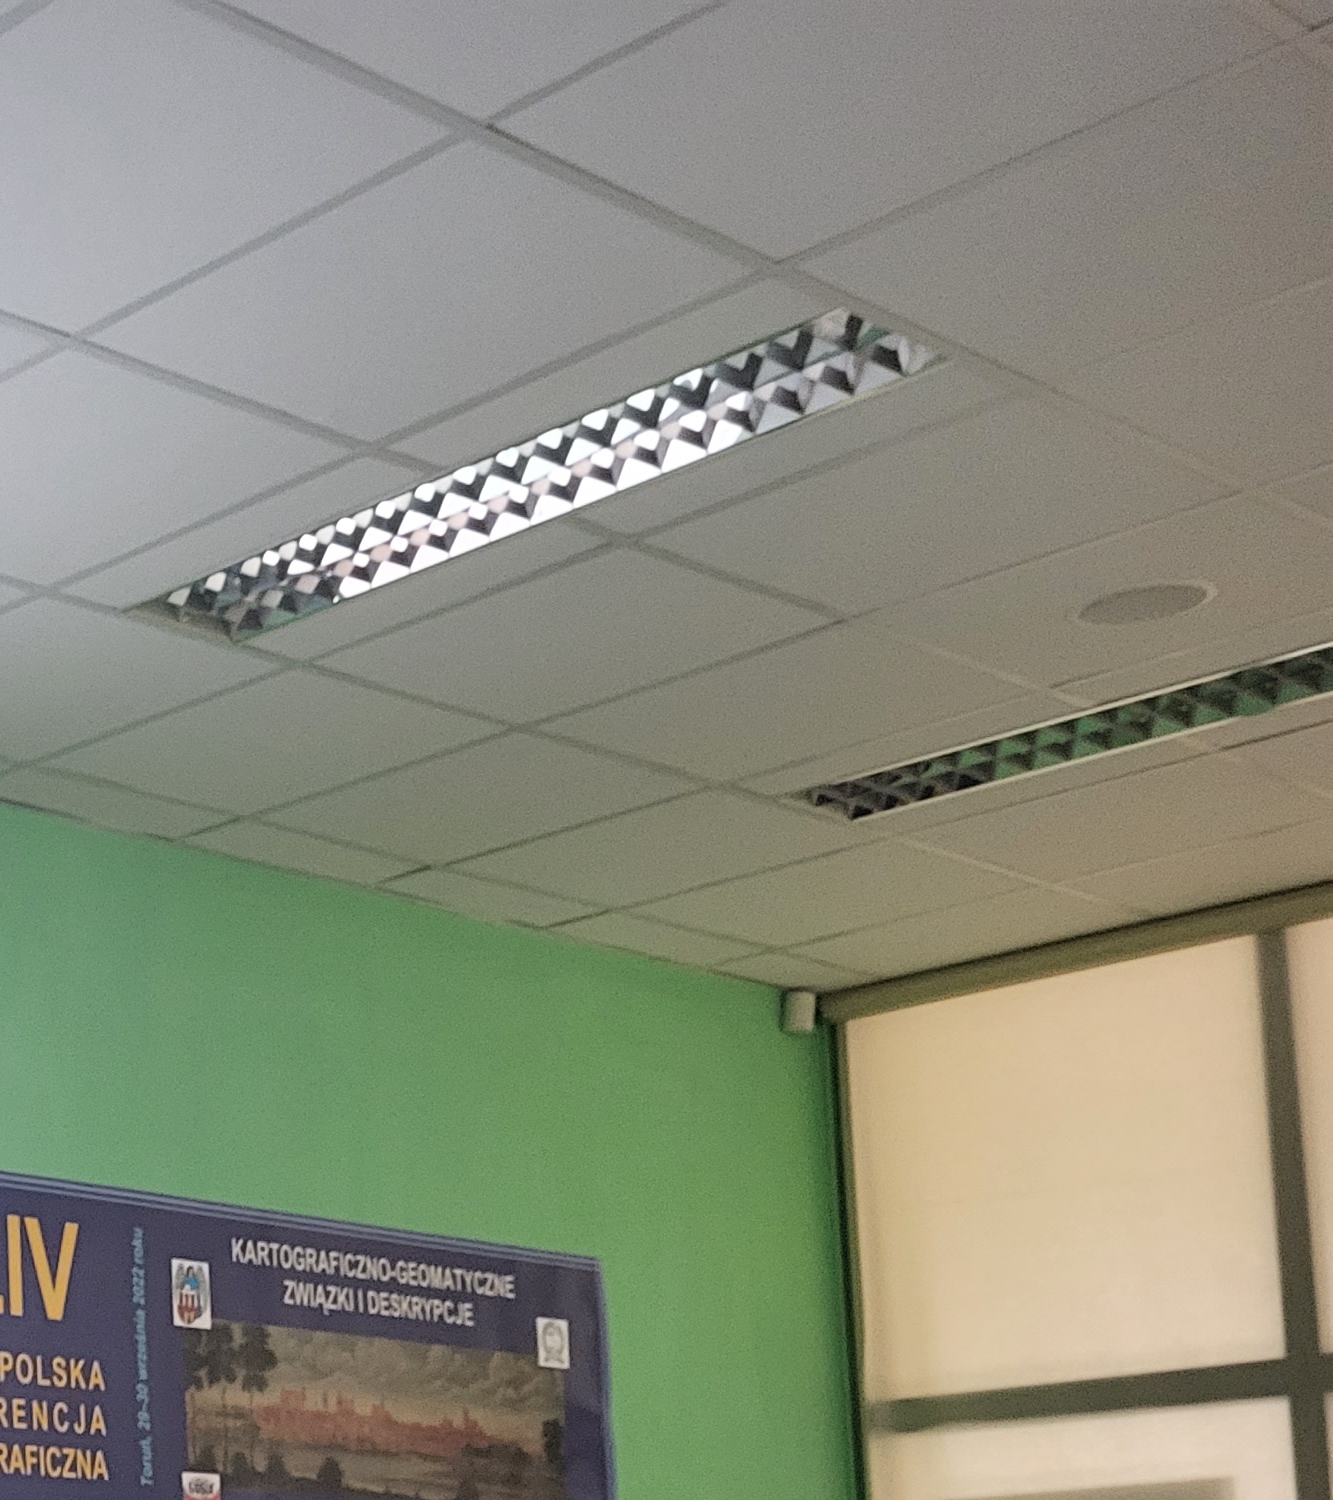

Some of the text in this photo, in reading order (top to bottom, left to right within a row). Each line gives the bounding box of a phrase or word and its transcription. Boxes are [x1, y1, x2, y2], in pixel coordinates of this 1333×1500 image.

[230, 1237, 517, 1300] KARTOGRAFICZNO-GEOMATYCZNE
[282, 1279, 475, 1328] ZWIĄZKI I DESKRYPCJE
